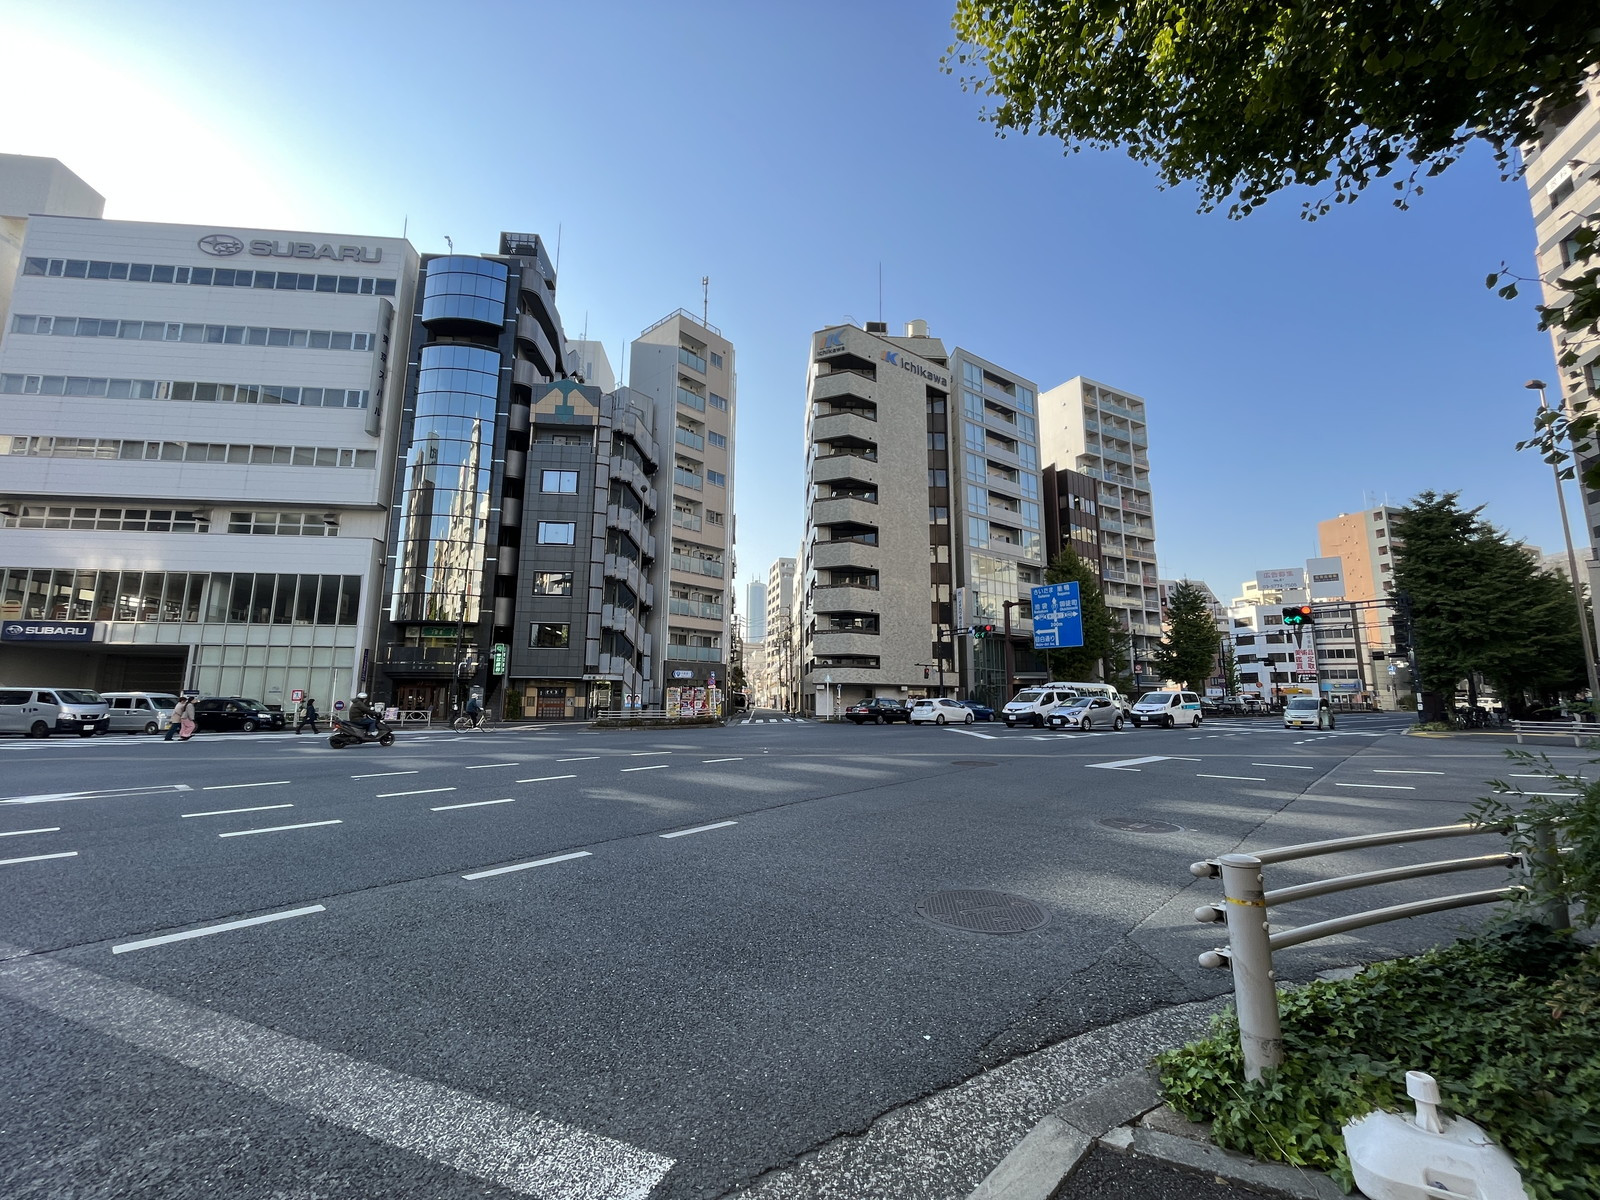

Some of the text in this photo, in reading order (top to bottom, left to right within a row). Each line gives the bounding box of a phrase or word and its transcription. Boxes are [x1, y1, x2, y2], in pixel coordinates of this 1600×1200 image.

[250, 239, 382, 263] SUBARU
[901, 358, 947, 387] ichikawa
[1033, 587, 1053, 596] さいたま
[25, 626, 87, 635] SUBARU
[1035, 635, 1055, 643] 目白通り
